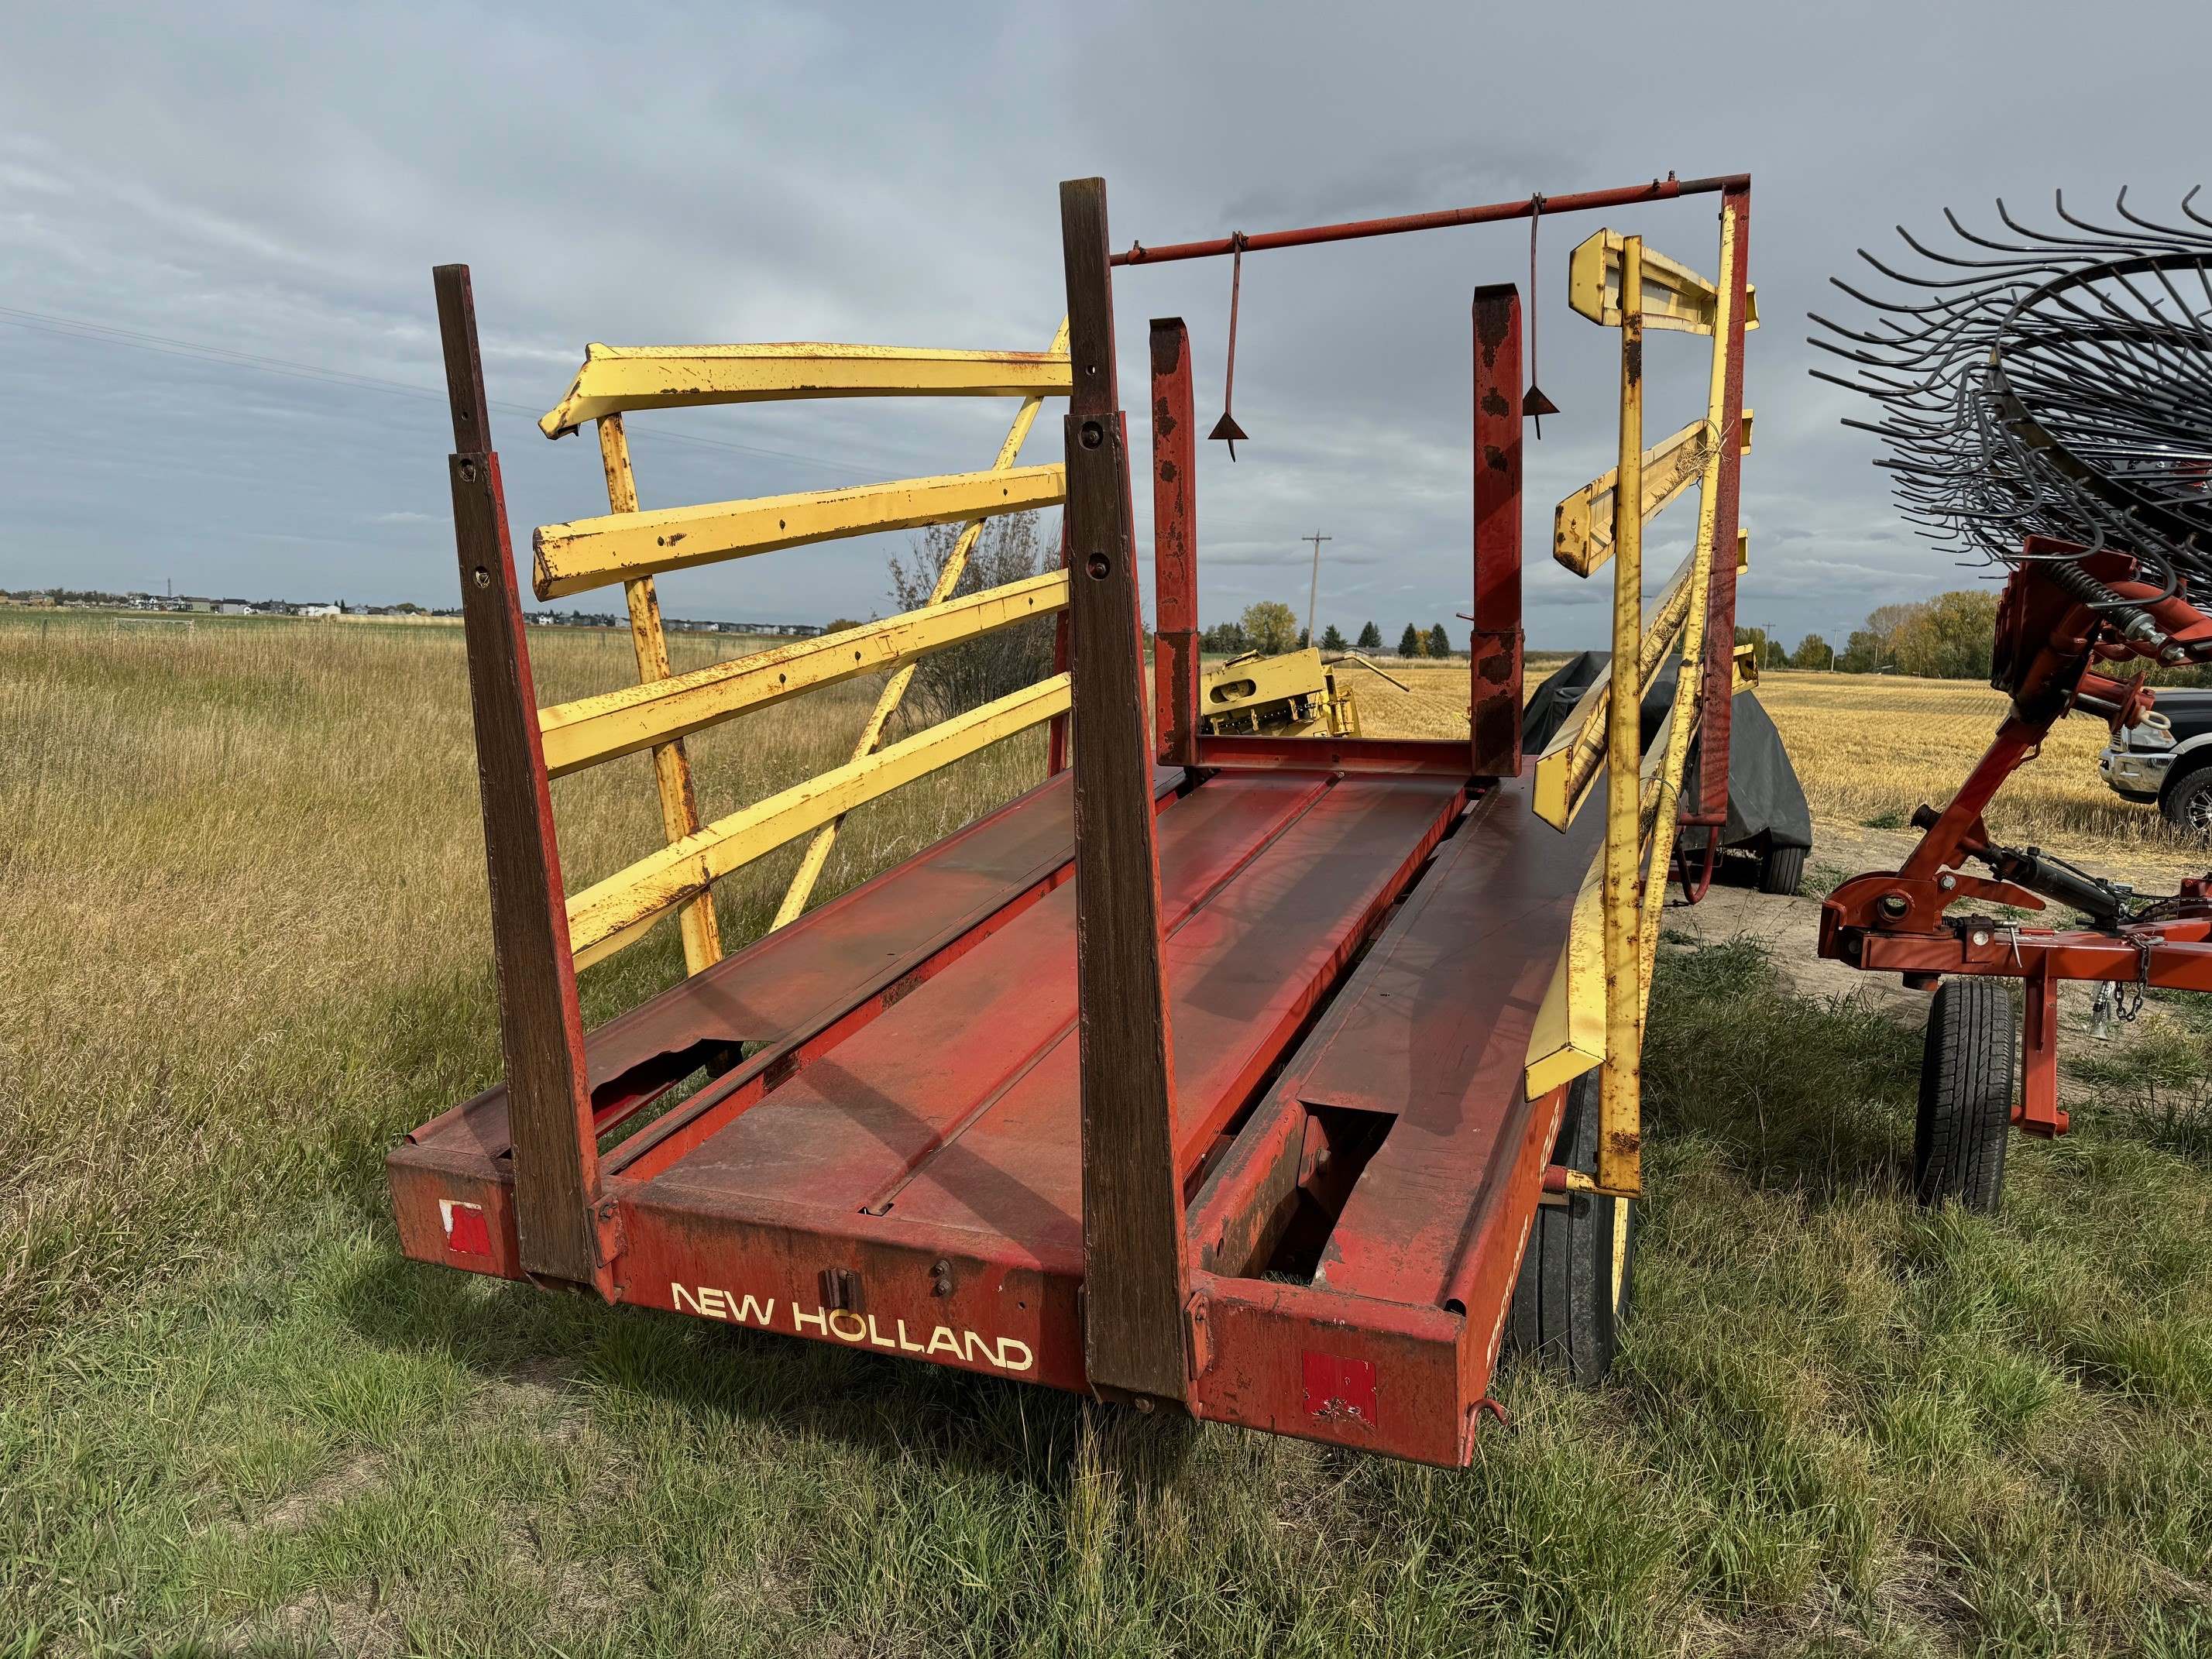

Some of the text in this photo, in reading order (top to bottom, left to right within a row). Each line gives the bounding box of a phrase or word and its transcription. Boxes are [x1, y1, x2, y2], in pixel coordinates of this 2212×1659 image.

[1539, 1096, 1560, 1186] 1002
[671, 1282, 1033, 1371] NEW HOLLAND
